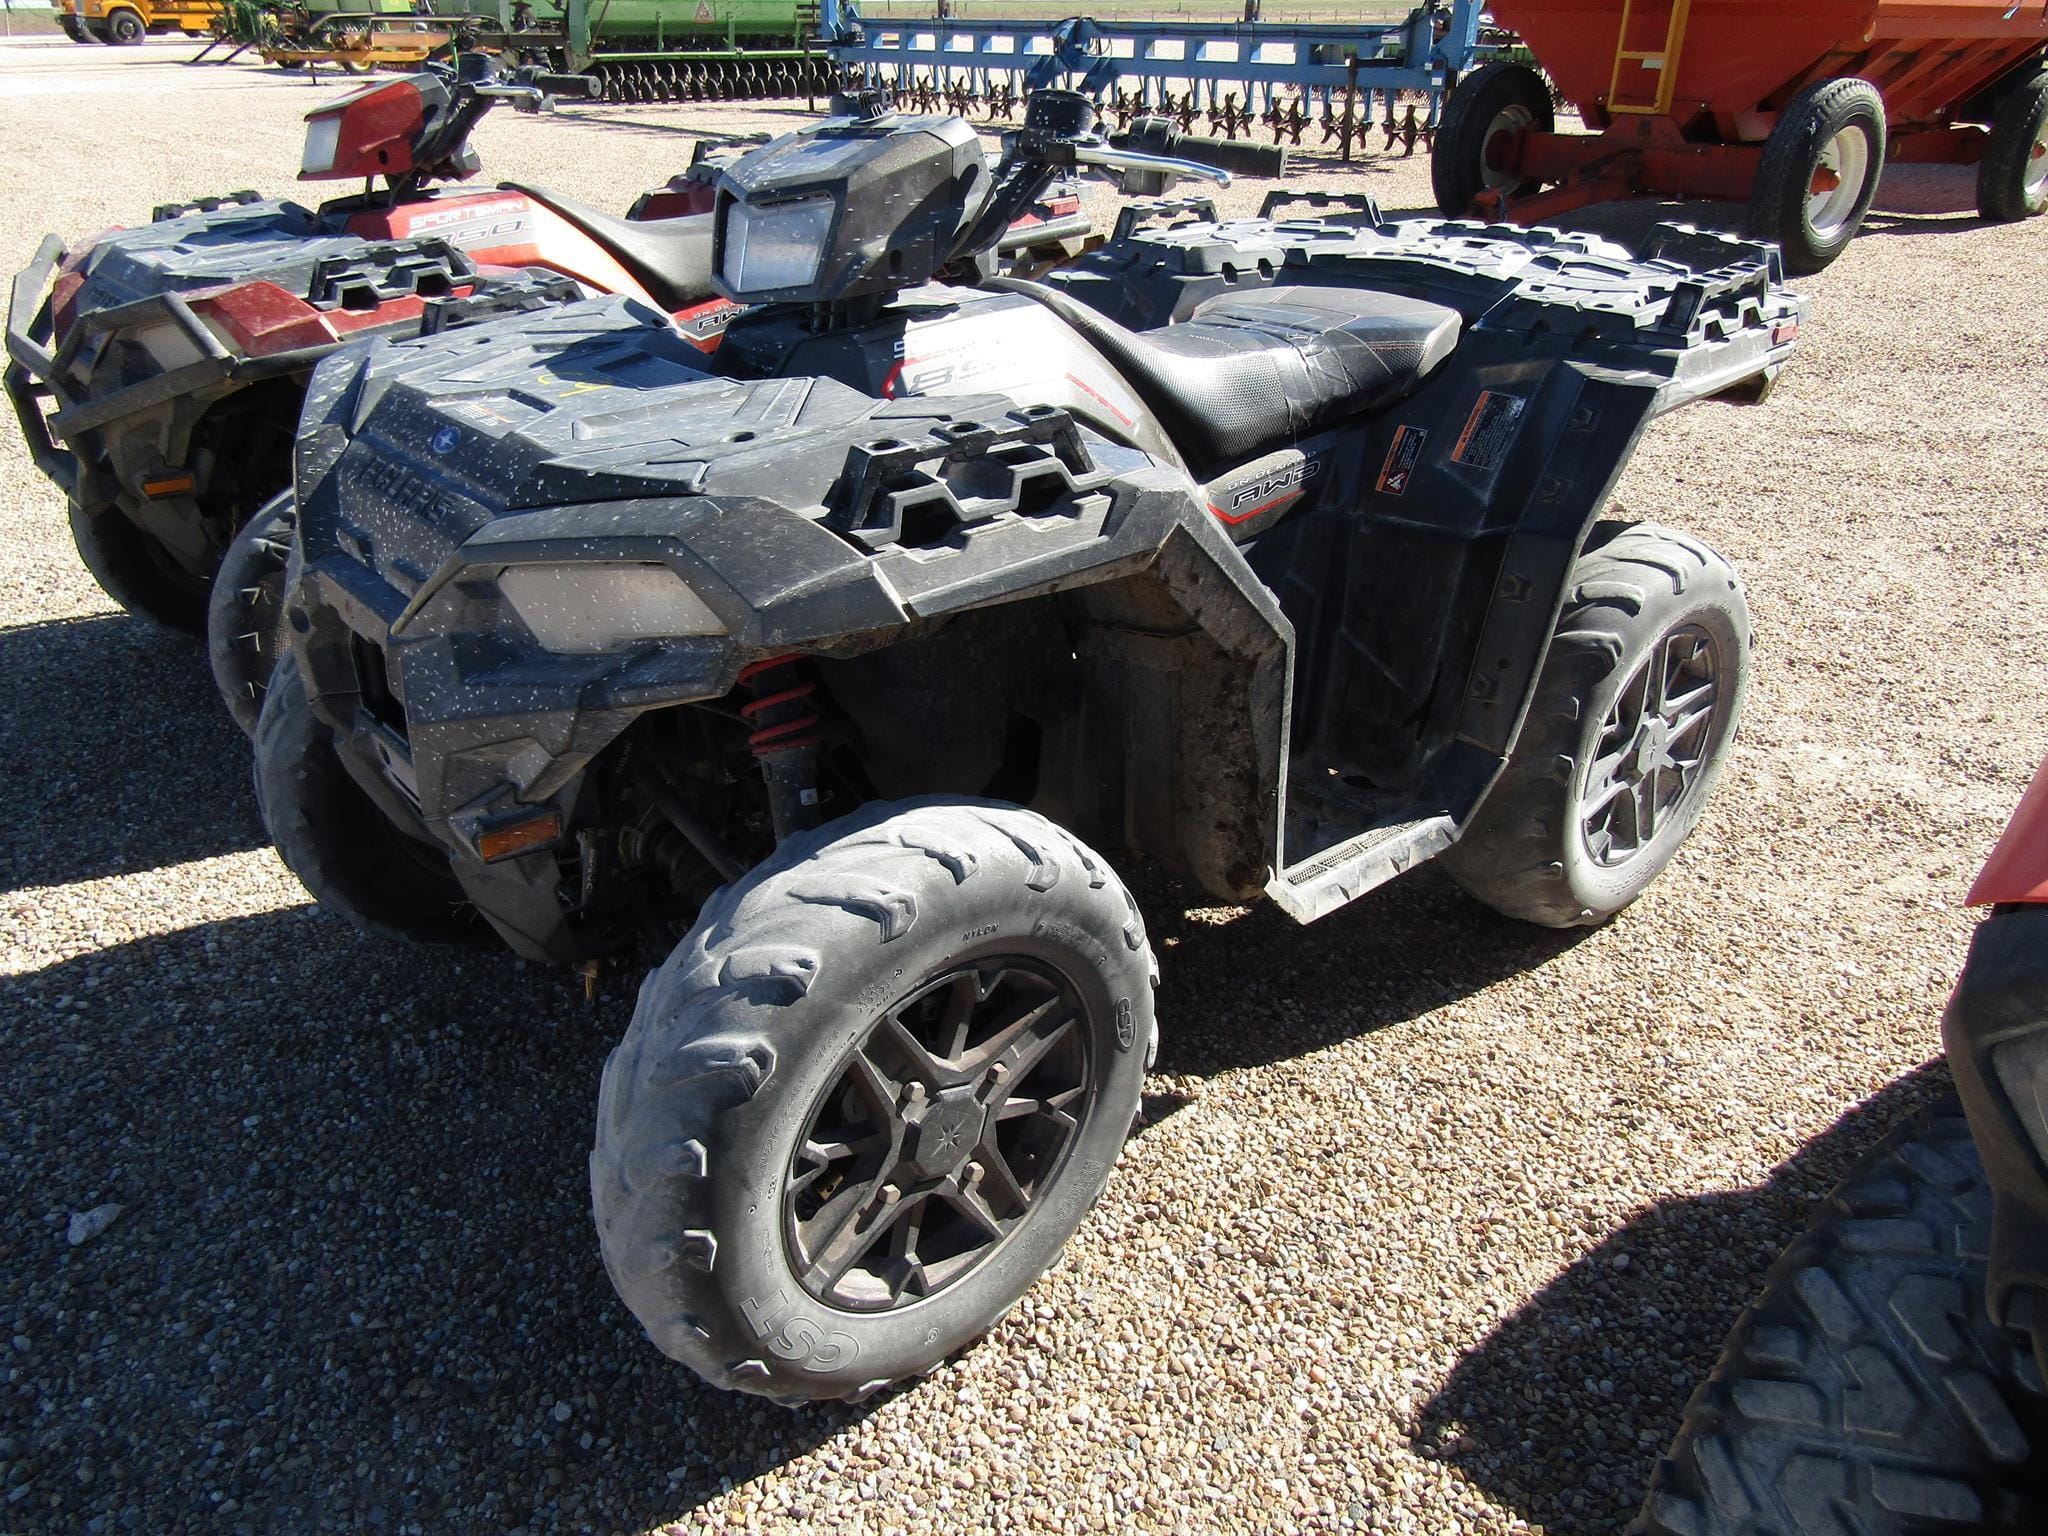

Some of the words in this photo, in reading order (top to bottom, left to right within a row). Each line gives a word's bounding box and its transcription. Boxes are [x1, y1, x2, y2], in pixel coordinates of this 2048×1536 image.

[410, 200, 523, 230] SPORTSMAN
[359, 454, 458, 525] POLARIS
[1227, 478, 1250, 491] ON
[1231, 460, 1320, 510] AWD
[962, 922, 999, 943] NYLON
[1116, 996, 1134, 1047] CST
[739, 1288, 861, 1373] CST
